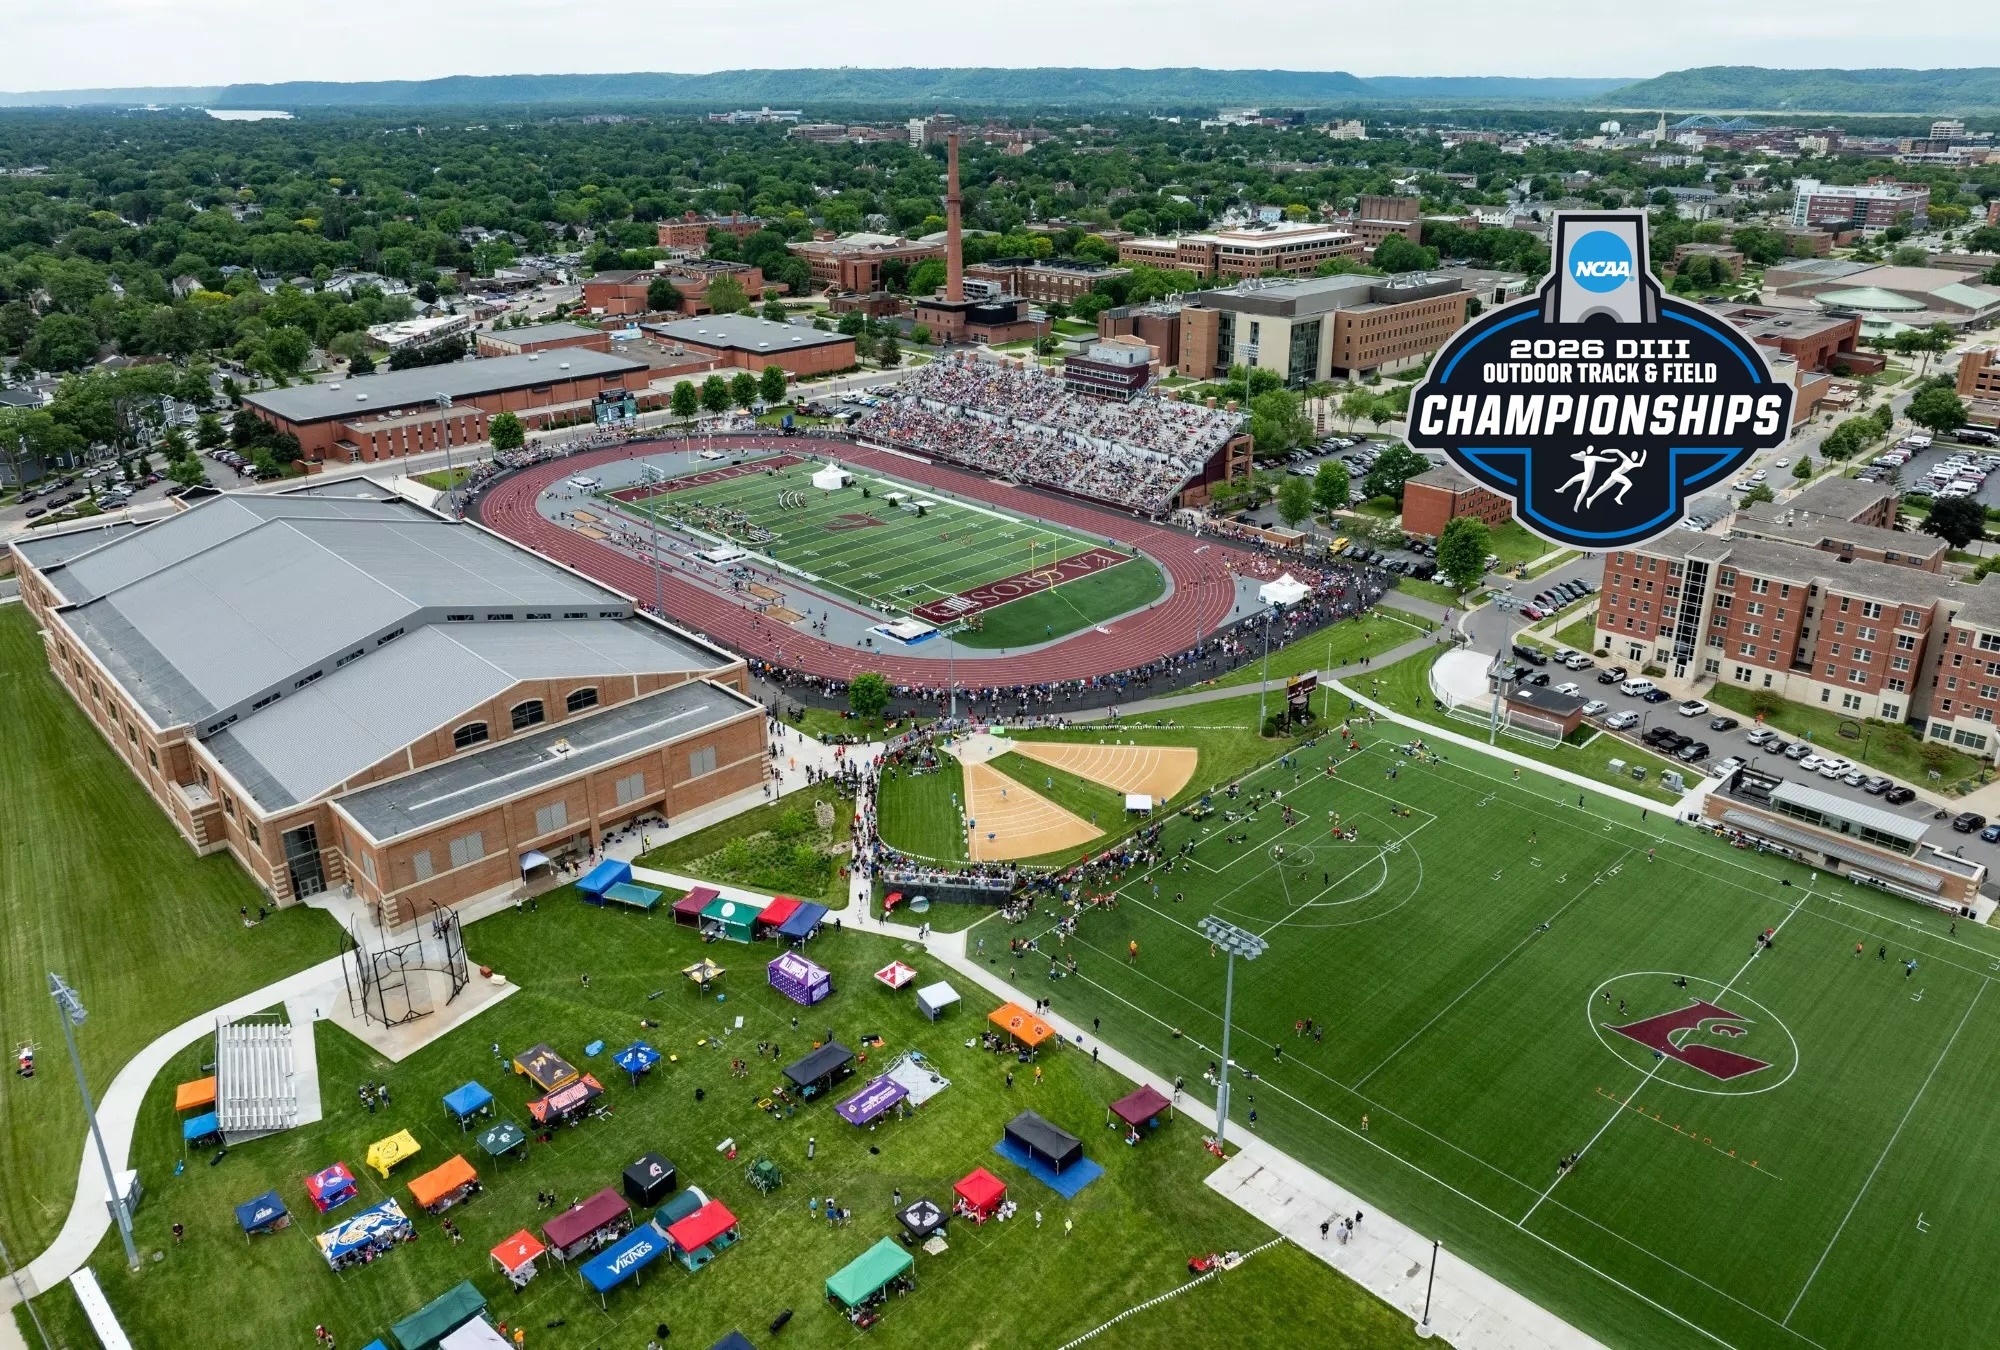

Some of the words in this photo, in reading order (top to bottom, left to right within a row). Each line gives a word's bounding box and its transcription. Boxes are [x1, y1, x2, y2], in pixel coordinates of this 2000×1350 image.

[651, 464, 772, 493] EAGLES
[927, 570, 1065, 617] CROSE
[606, 1242, 653, 1275] VIKINGS
